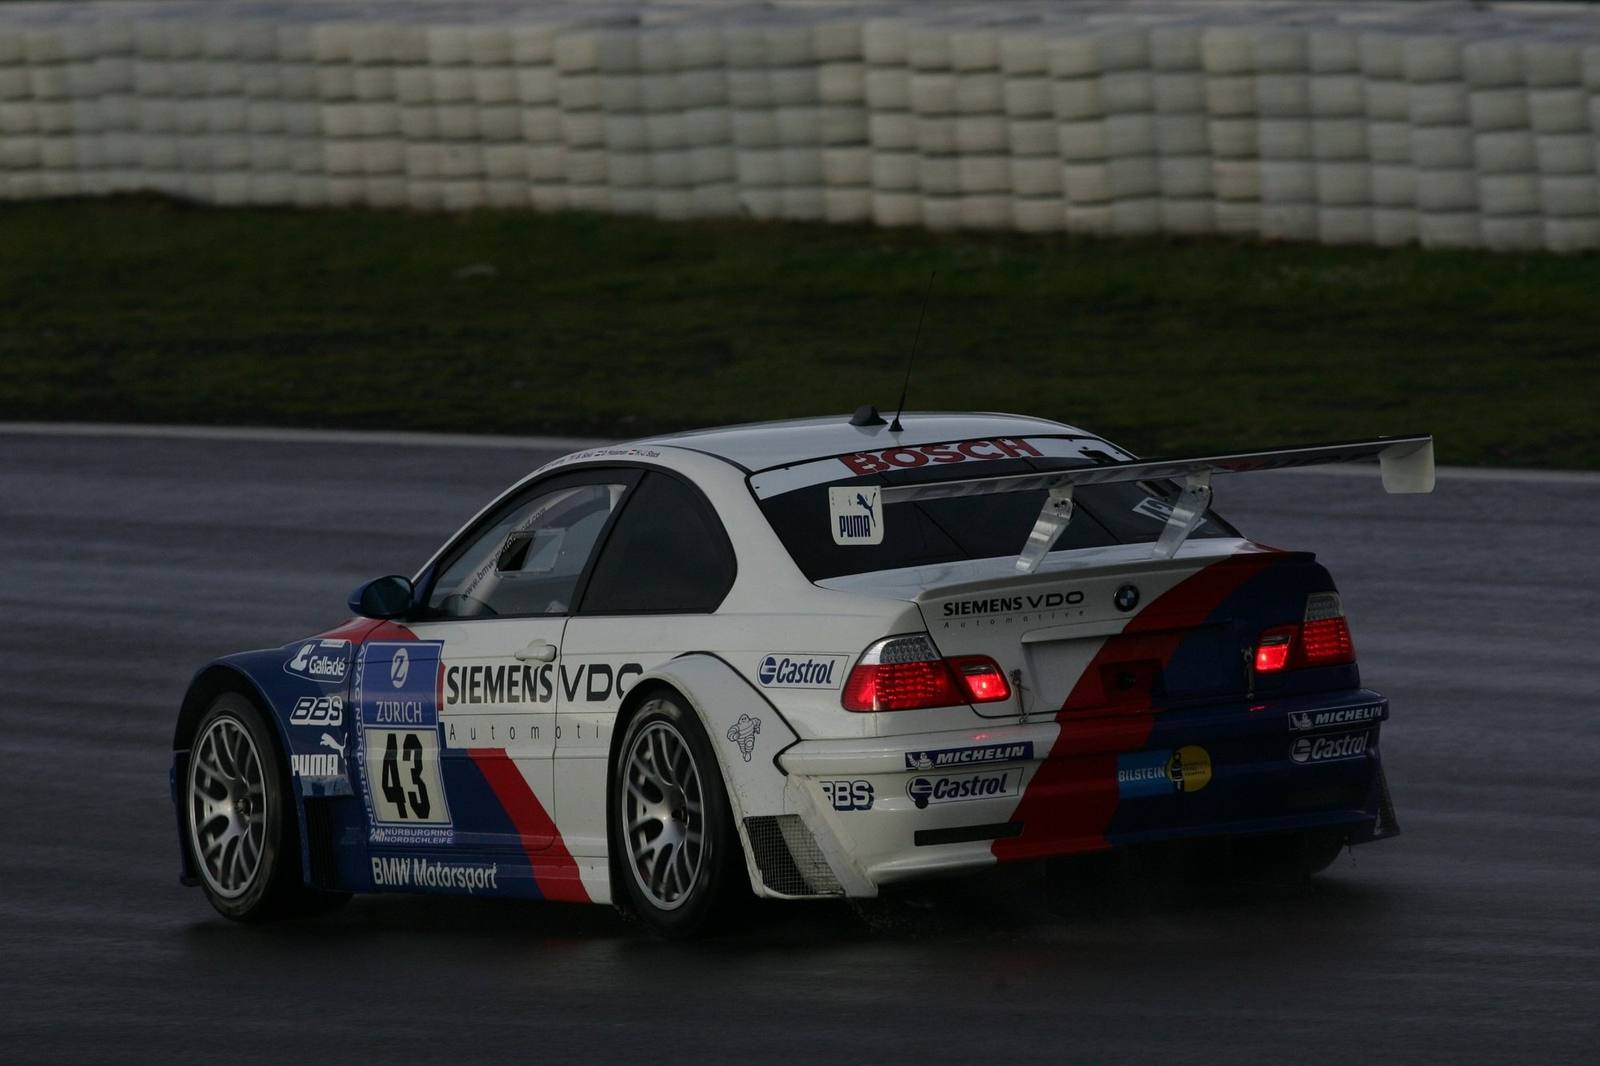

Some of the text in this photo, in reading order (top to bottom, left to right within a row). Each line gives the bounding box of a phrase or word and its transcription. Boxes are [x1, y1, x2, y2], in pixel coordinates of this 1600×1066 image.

[839, 438, 1044, 476] BOSCH
[839, 515, 871, 538] PUMA
[944, 591, 1084, 616] SIEMENS VDO
[944, 610, 1085, 628] Automotive
[309, 656, 346, 677] Galladé
[776, 657, 835, 685] Castrol
[446, 664, 553, 705] SIEMENS
[289, 695, 343, 727] BBS
[1315, 706, 1383, 726] MICHELIN
[355, 645, 376, 826] ADAC NORDRHEIN
[450, 720, 599, 741] Automoti
[935, 745, 1025, 765] MICHELIN
[1312, 731, 1369, 759] Castrol
[291, 754, 338, 777] PUMA
[382, 733, 431, 819] 43
[1118, 765, 1165, 783] BILSTEIN
[934, 773, 1006, 799] Castrol
[384, 827, 454, 838] NÜRBURGRING
[384, 836, 453, 845] NORDSCHLEIFE
[371, 856, 498, 893] BMW Motorsport
